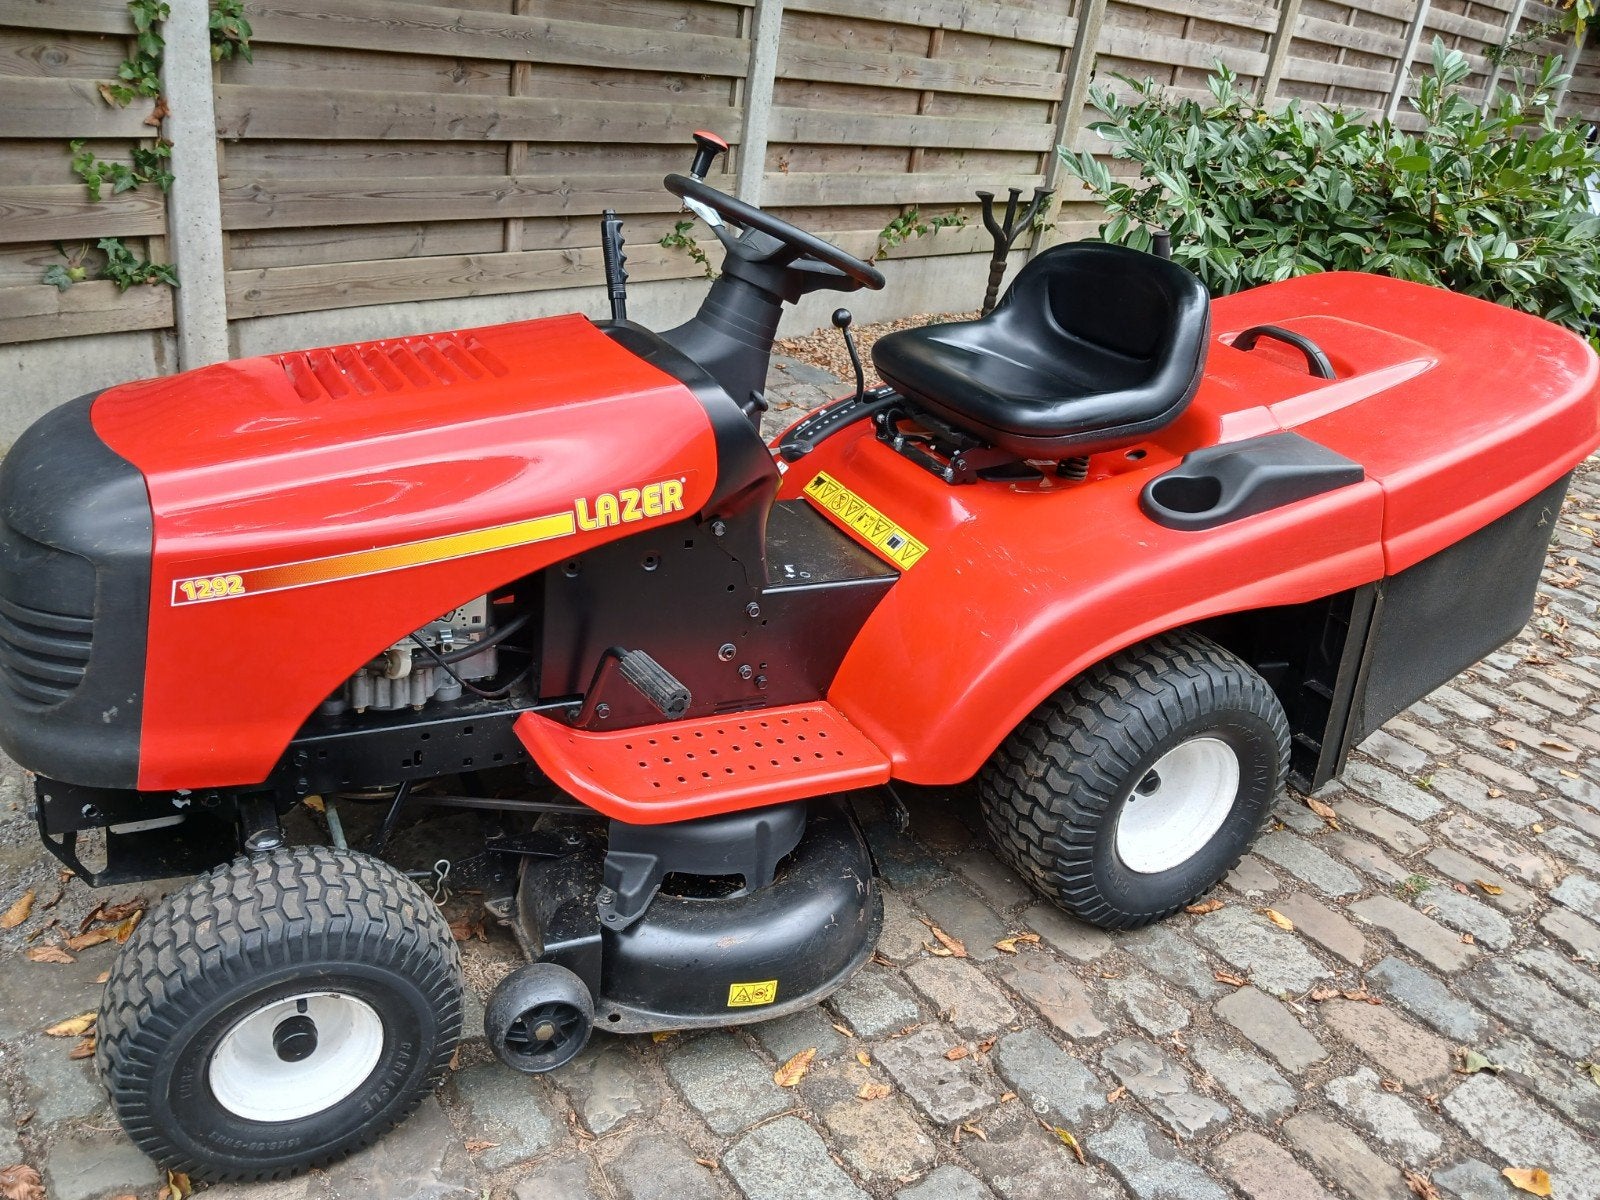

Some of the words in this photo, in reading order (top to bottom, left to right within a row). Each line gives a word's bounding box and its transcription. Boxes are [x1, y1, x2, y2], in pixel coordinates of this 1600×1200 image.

[574, 479, 684, 532] LAZER
[180, 574, 245, 600] 1292
[360, 1040, 412, 1114] CARLISLE
